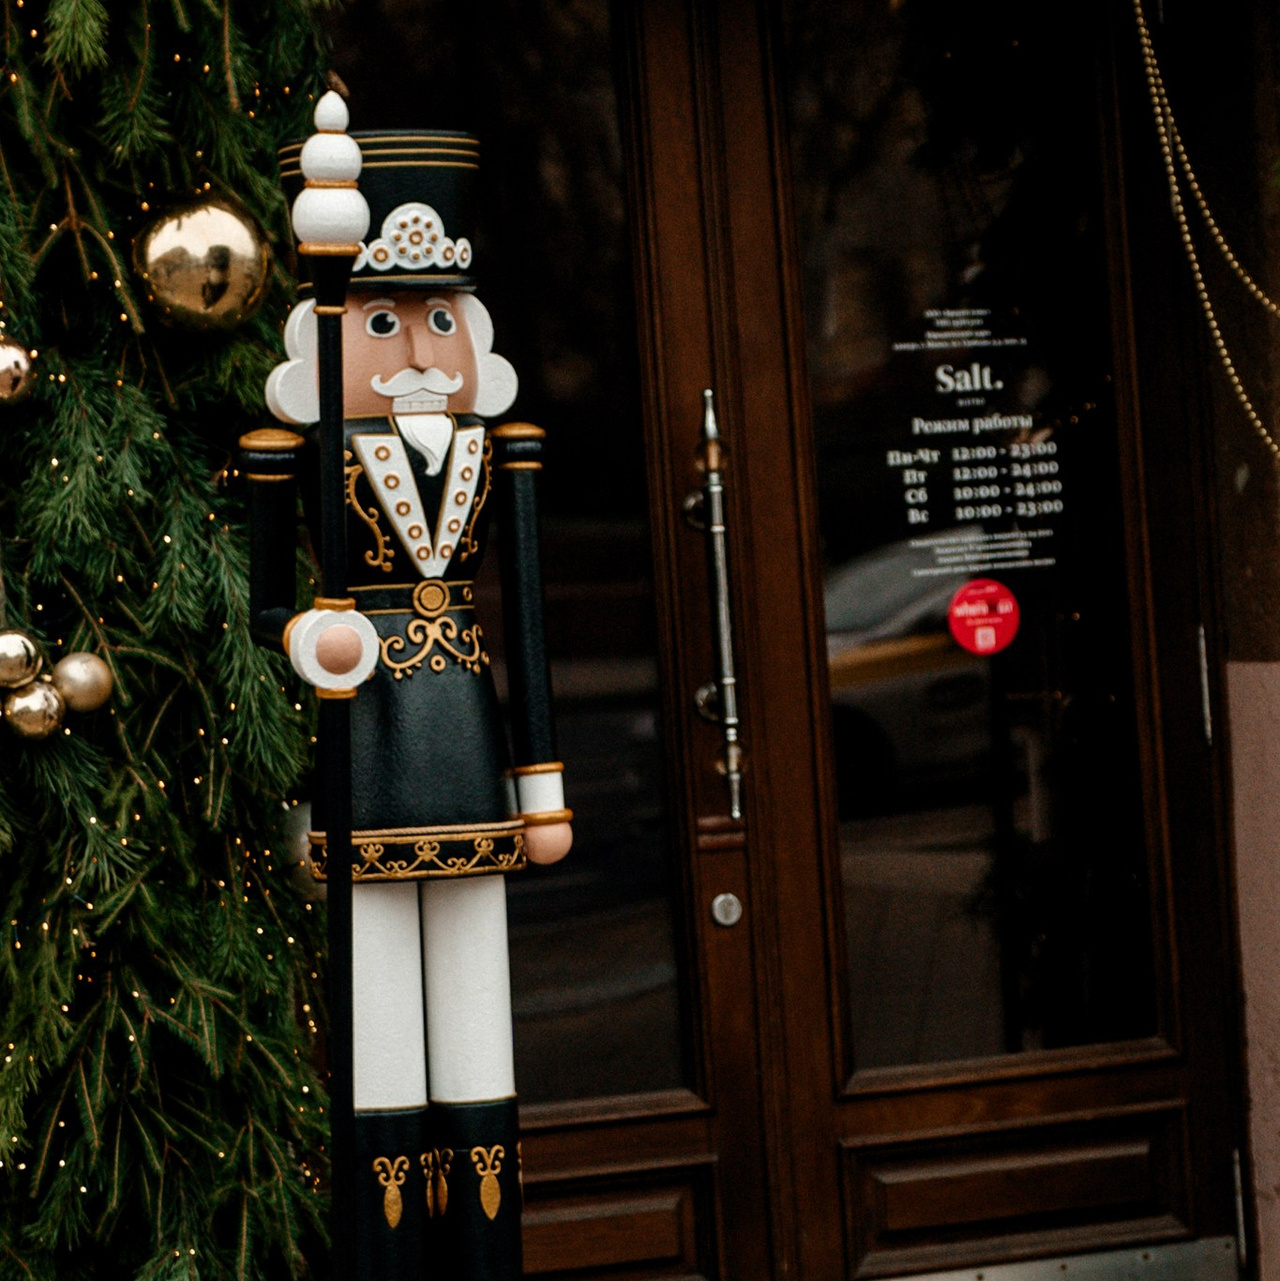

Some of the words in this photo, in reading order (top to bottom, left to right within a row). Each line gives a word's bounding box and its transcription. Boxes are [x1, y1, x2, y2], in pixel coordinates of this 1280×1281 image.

[936, 363, 1003, 393] Salt.
[912, 417, 969, 435] Режим
[972, 413, 1033, 435] работы
[887, 448, 941, 466] Пн-Чт
[952, 446, 997, 461] 12:00
[1010, 441, 1057, 459] 23:00
[903, 469, 928, 485] Пт
[953, 466, 998, 481] 12:00
[1011, 461, 1059, 478] 24:00
[904, 487, 928, 504] Сб
[954, 484, 1000, 501] 10:00
[1014, 480, 1062, 498] 24:00
[907, 508, 929, 524] Вс
[955, 504, 1002, 520] 10:00
[1016, 499, 1063, 517] 23:00
